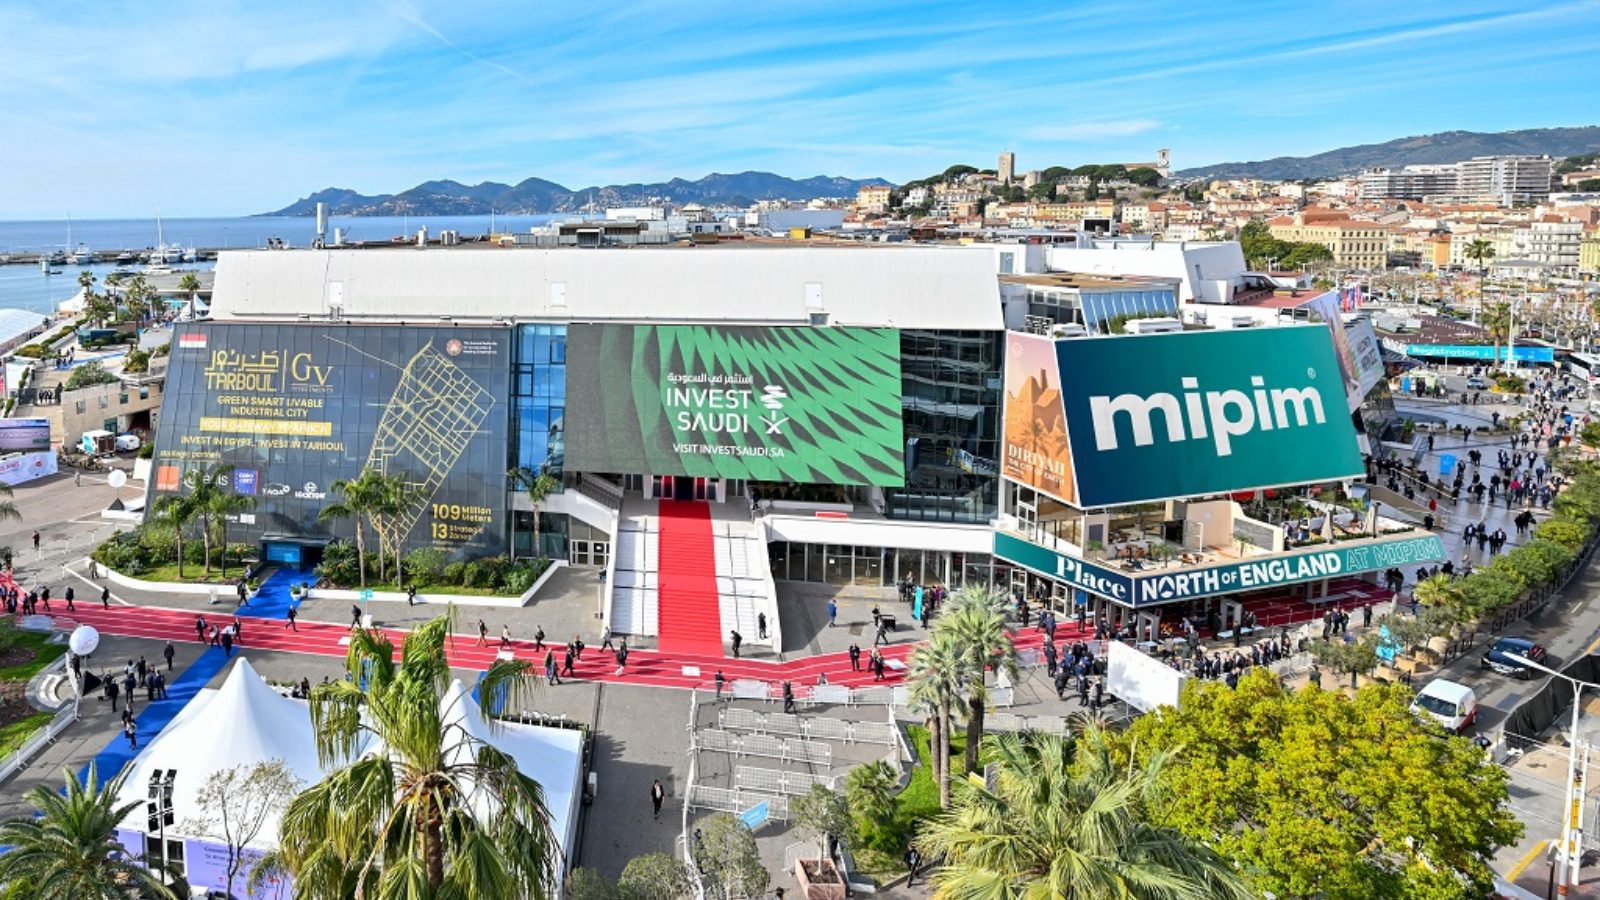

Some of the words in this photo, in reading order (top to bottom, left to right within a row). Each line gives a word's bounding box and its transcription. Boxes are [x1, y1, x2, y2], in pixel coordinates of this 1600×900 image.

[1412, 344, 1479, 357] Registration
[204, 372, 277, 392] TARBOUL
[217, 396, 249, 405] GREEN
[250, 397, 285, 406] SMART
[287, 398, 324, 408] LIVABLE
[667, 388, 752, 409] INVEST
[230, 406, 285, 417] INDUSTRIAL
[287, 408, 309, 417] CITY
[1089, 374, 1326, 457] mipim
[677, 412, 748, 433] SAUDI
[181, 436, 211, 445] INVEST
[257, 439, 288, 448] INVEST
[303, 441, 345, 452] TARBOUL
[673, 443, 699, 453] VISIT
[700, 444, 784, 457] INVESTSAUDI.SA
[1008, 444, 1065, 477] DIRIYAH
[432, 504, 460, 520] 109
[462, 506, 492, 515] Million
[432, 523, 448, 539] 13
[1056, 555, 1126, 599] Place
[1141, 569, 1220, 601] NORTH
[1221, 572, 1237, 585] OF
[1238, 552, 1341, 586] ENGLAND
[1346, 548, 1370, 571] AT
[1373, 537, 1443, 567] MIPIM
